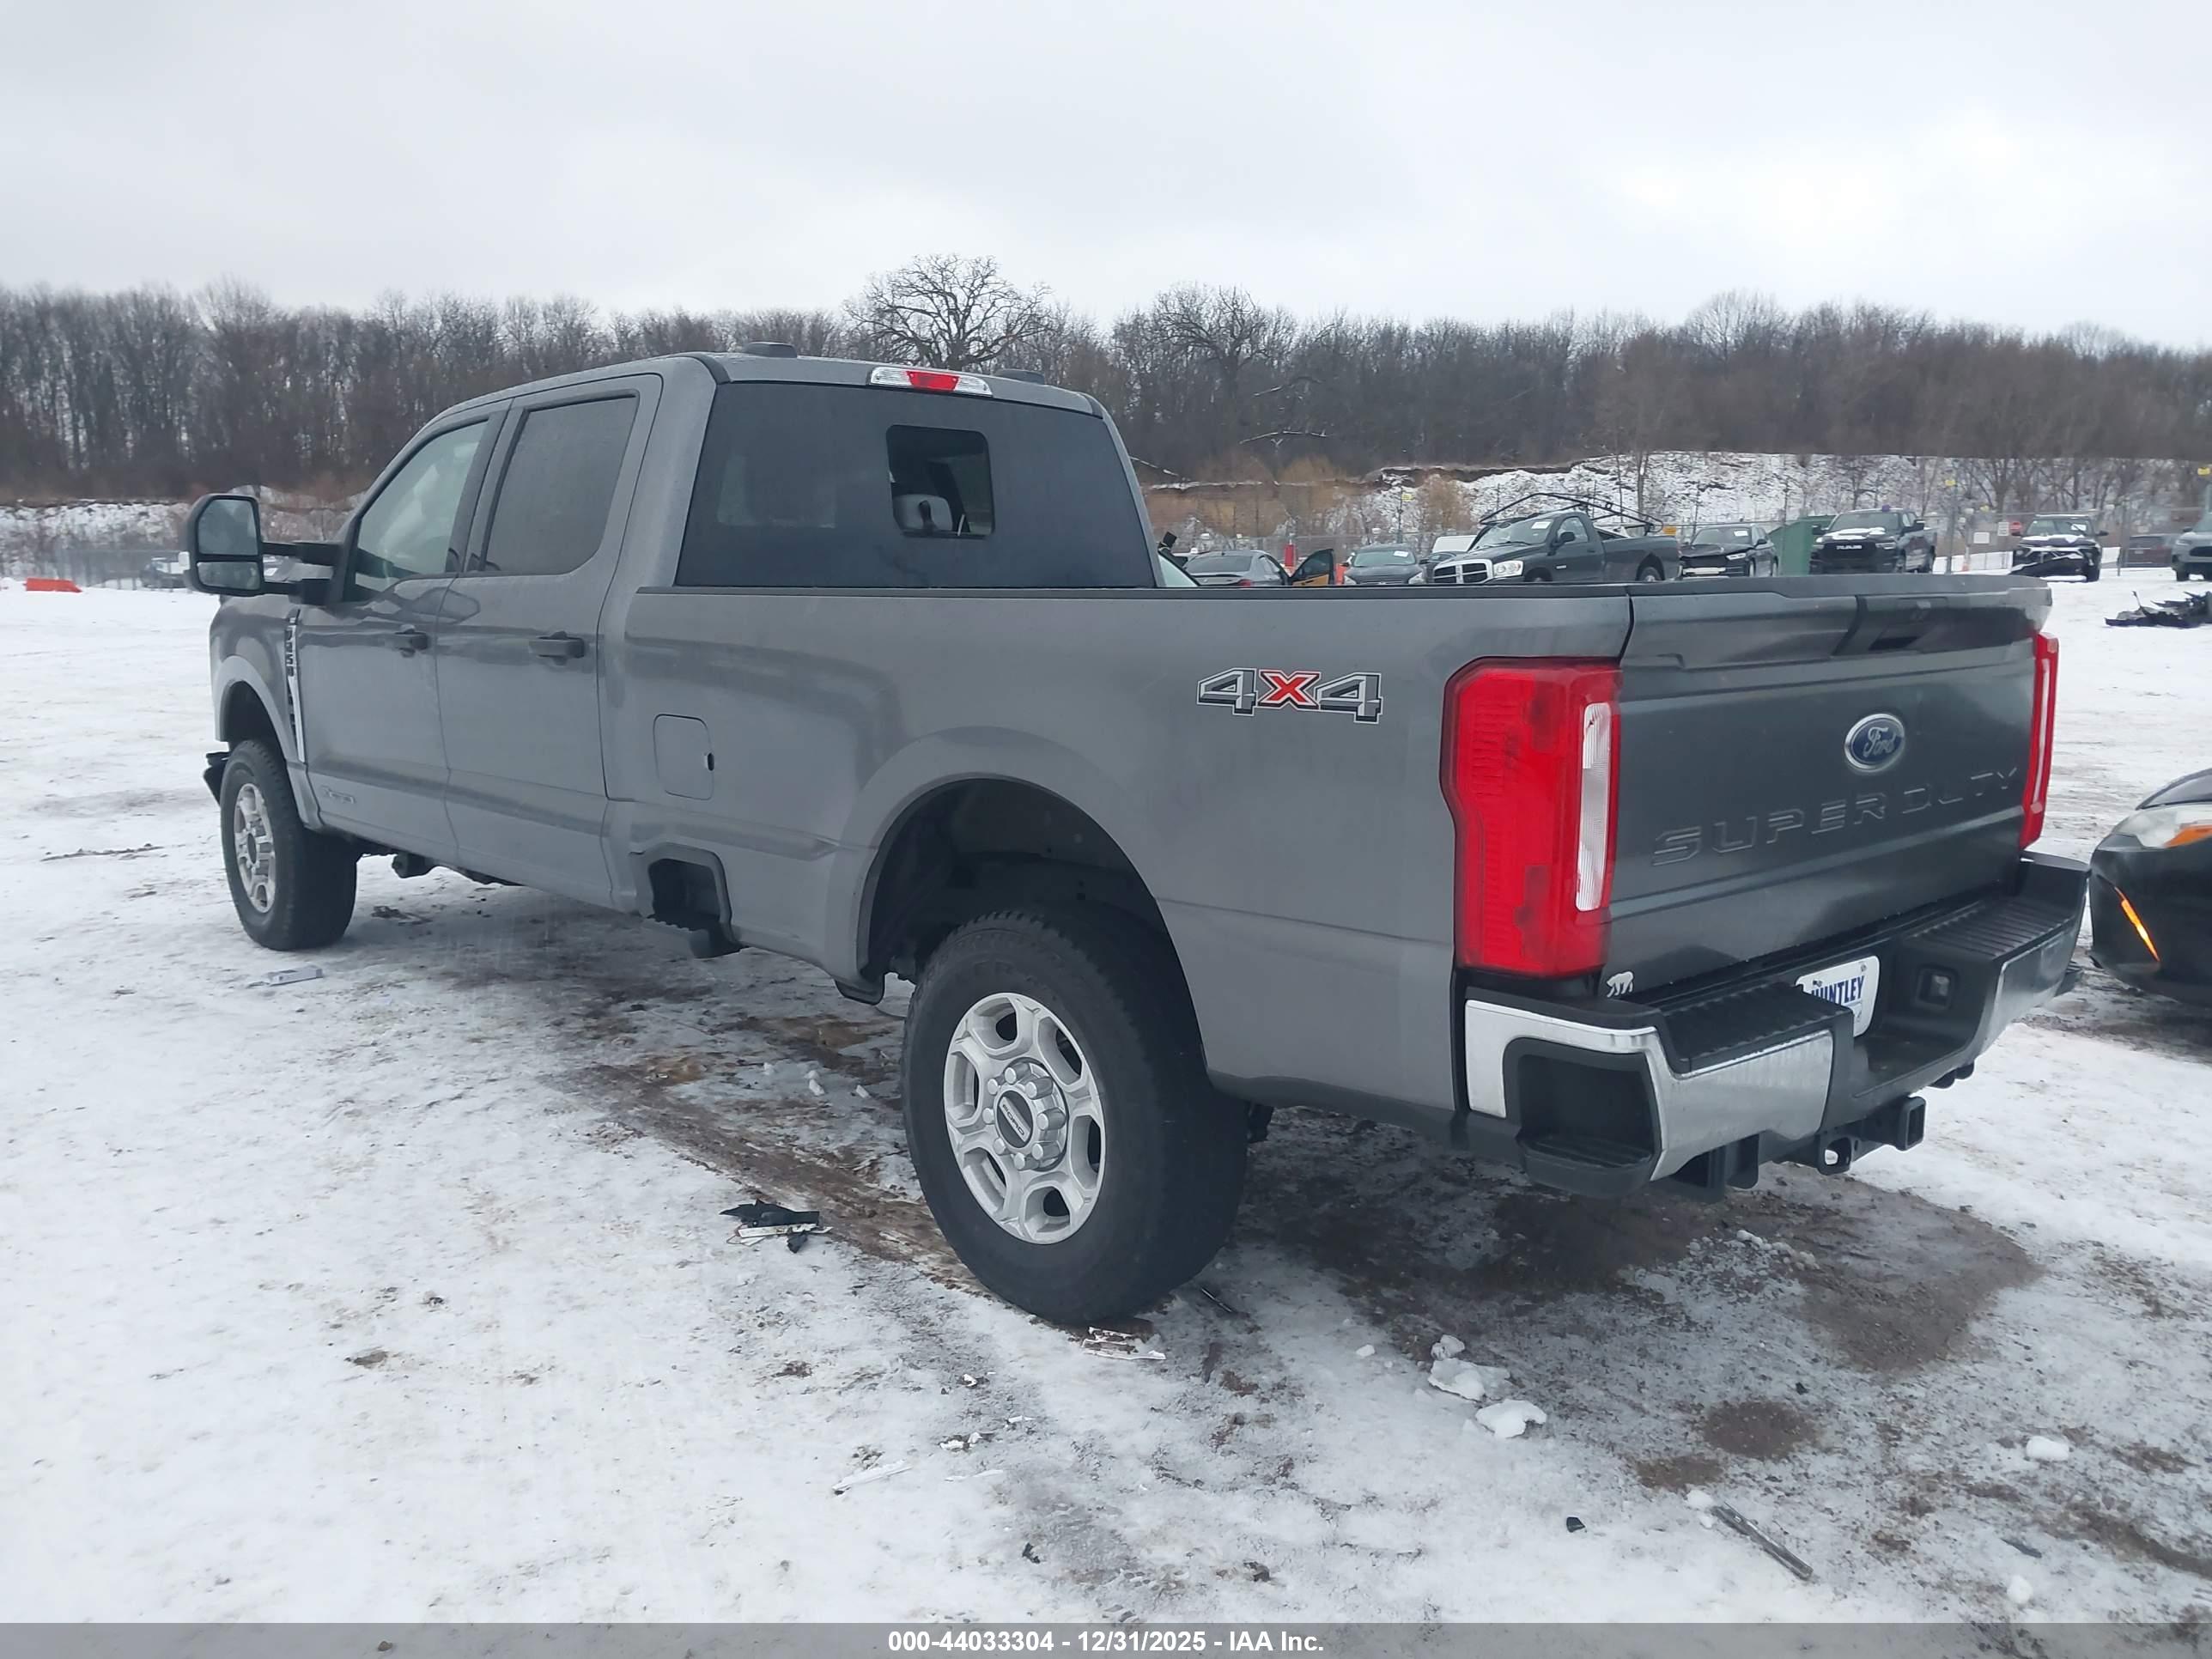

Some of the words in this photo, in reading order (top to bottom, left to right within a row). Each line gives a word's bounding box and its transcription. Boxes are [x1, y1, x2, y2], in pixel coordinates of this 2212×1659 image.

[1863, 726, 1897, 757] Ford
[1651, 792, 1887, 866] SUPER
[1002, 1103, 1025, 1136] FORD
